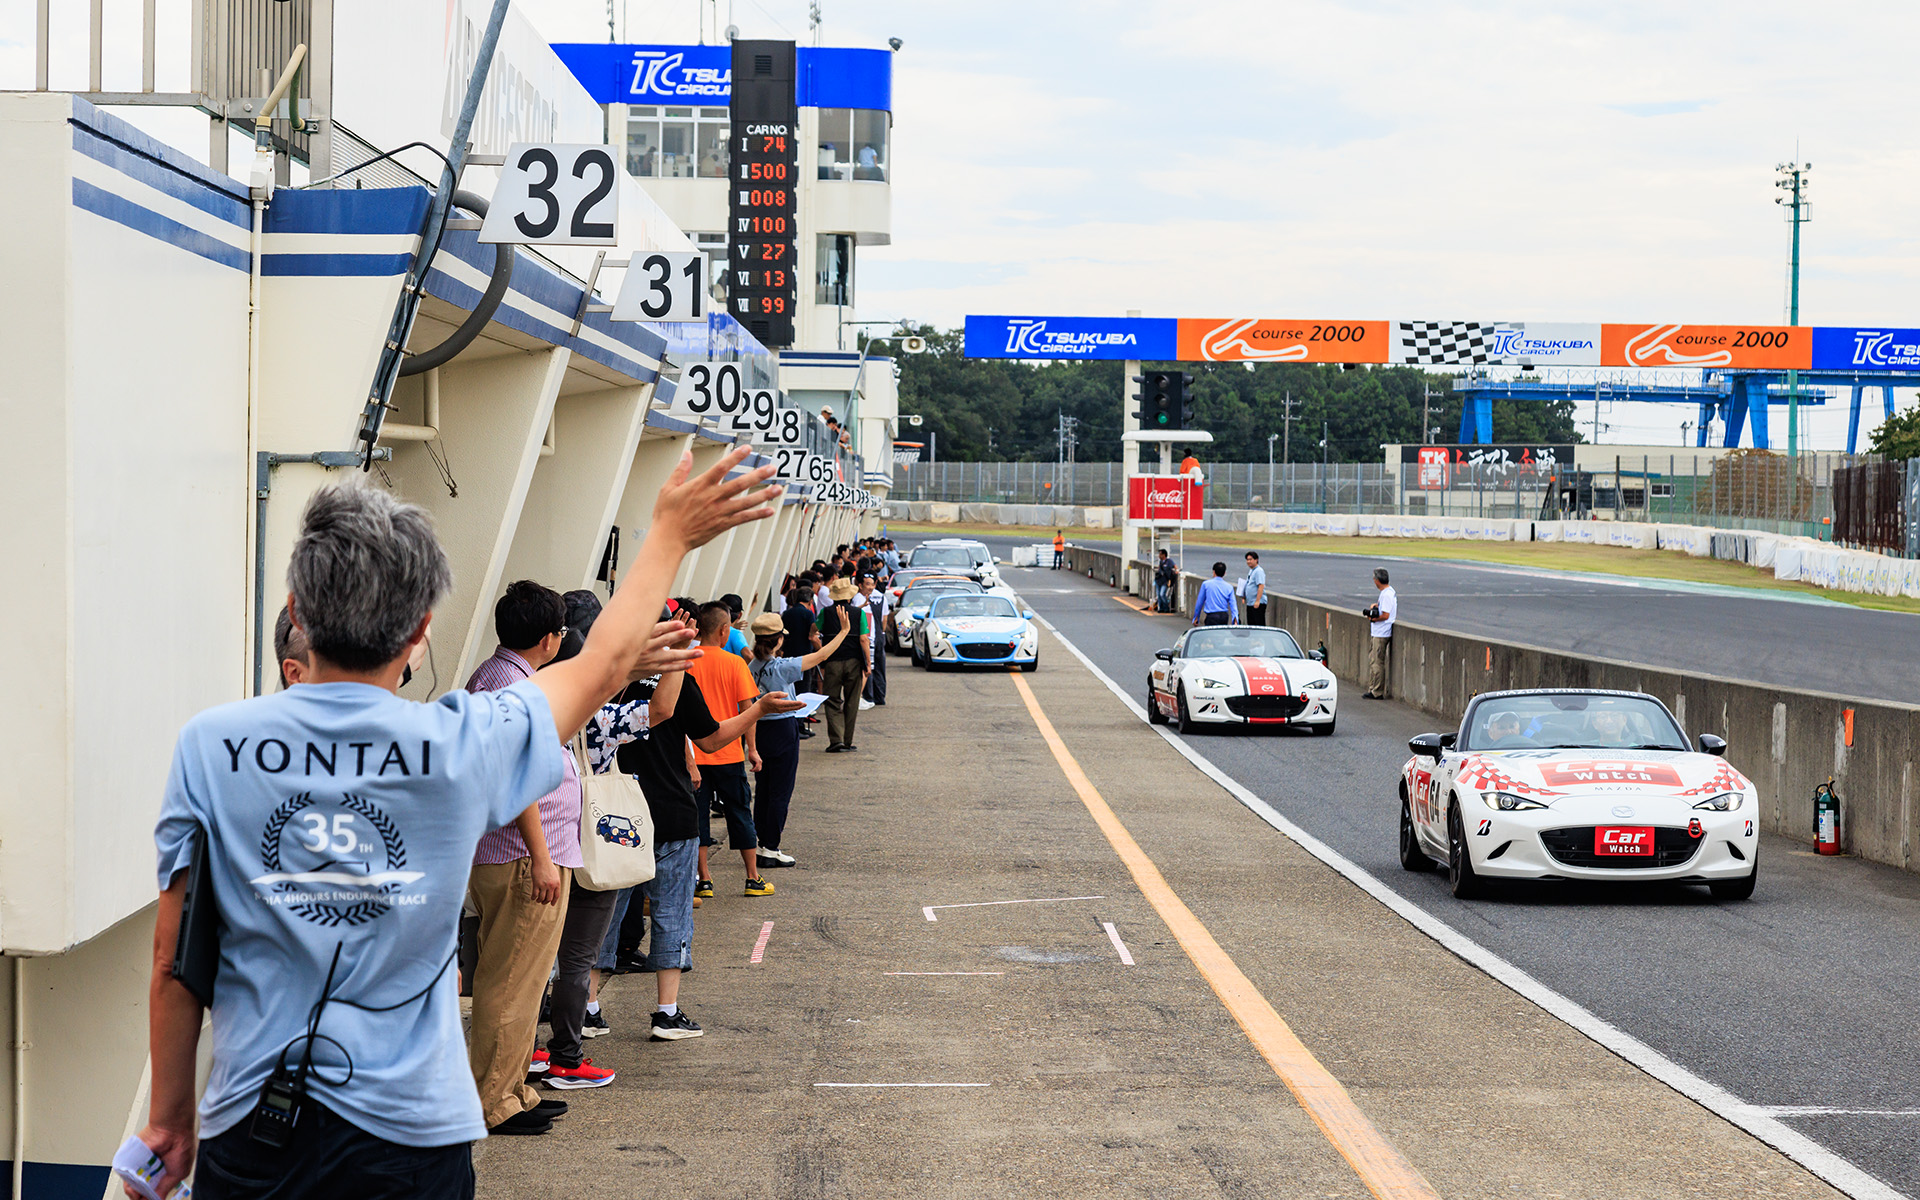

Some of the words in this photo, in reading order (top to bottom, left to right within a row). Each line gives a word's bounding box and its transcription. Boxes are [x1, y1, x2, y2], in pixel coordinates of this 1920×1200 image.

[682, 68, 731, 83] TSU
[764, 137, 786, 152] 74
[751, 163, 786, 180] 500
[514, 148, 614, 238] 32
[751, 190, 786, 206] 008
[753, 217, 786, 233] 100
[763, 244, 785, 260] 27
[640, 255, 702, 318] 31
[764, 271, 785, 287] 13
[762, 297, 785, 314] 99
[1045, 332, 1137, 345] TSUKUBA
[1252, 329, 1304, 339] course
[1308, 325, 1365, 342] 2000
[1676, 335, 1727, 345] course
[1731, 331, 1788, 348] 2000
[1524, 340, 1593, 349] TSUKUBA
[688, 365, 740, 413] 30
[776, 450, 807, 478] 27
[1421, 451, 1446, 467] TK
[1456, 448, 1556, 477] トラスト企画
[816, 483, 838, 502] 24
[1496, 688, 1544, 697] MAZDA
[1592, 688, 1639, 698] RACING
[223, 737, 430, 777] YONTAI
[1555, 760, 1659, 773] Car
[1573, 772, 1652, 782] Watch
[303, 813, 357, 853] 35
[359, 843, 373, 853] TH
[1603, 830, 1646, 843] Car
[1609, 844, 1641, 854] Watch
[284, 890, 331, 903] 4HOURS
[398, 894, 427, 905] RACE
